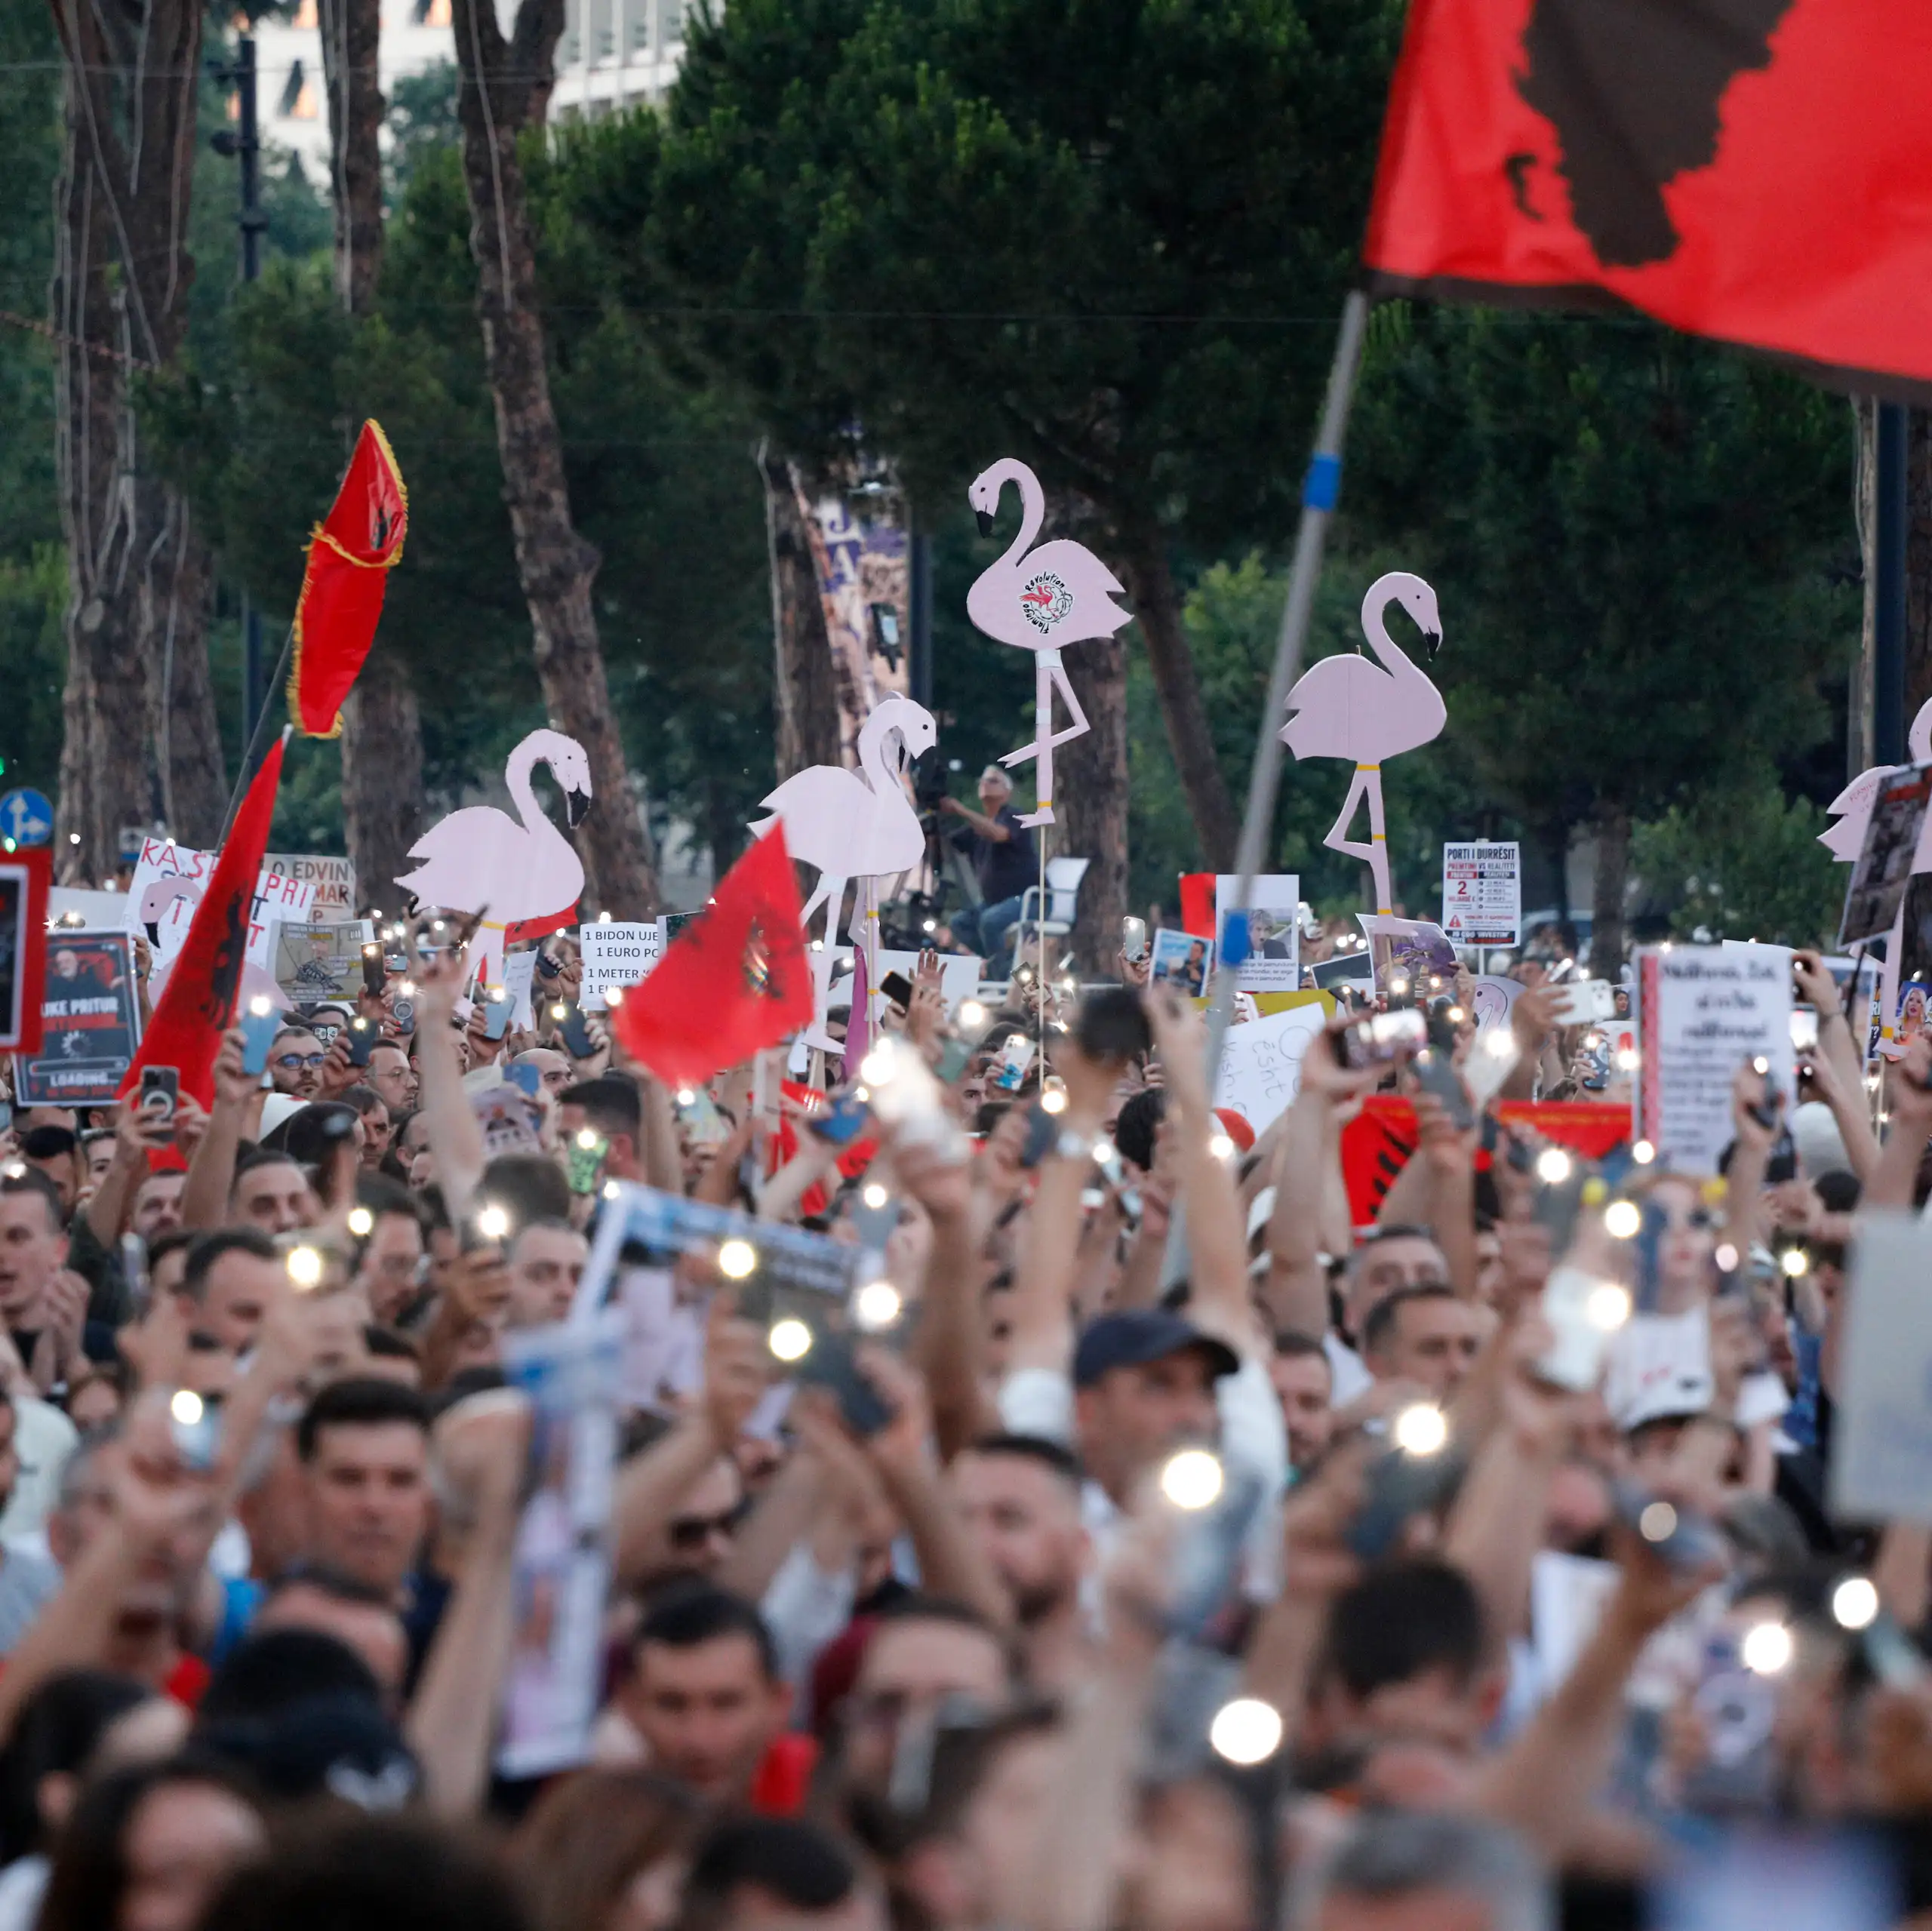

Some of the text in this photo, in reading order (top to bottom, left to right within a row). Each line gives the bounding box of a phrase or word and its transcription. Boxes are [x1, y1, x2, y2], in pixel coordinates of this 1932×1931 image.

[1025, 571, 1065, 592] Revolution
[1023, 604, 1049, 634] Flamingo
[1447, 848, 1469, 859] PORTI
[1477, 846, 1515, 860] DURRËSIT
[293, 861, 349, 882] EDVIN
[1457, 881, 1467, 895] 2
[585, 932, 591, 941] 1
[595, 930, 635, 941] BIDON
[596, 947, 603, 957] 1
[607, 947, 641, 958] EURO
[588, 968, 595, 978] 1
[598, 969, 639, 979] METER
